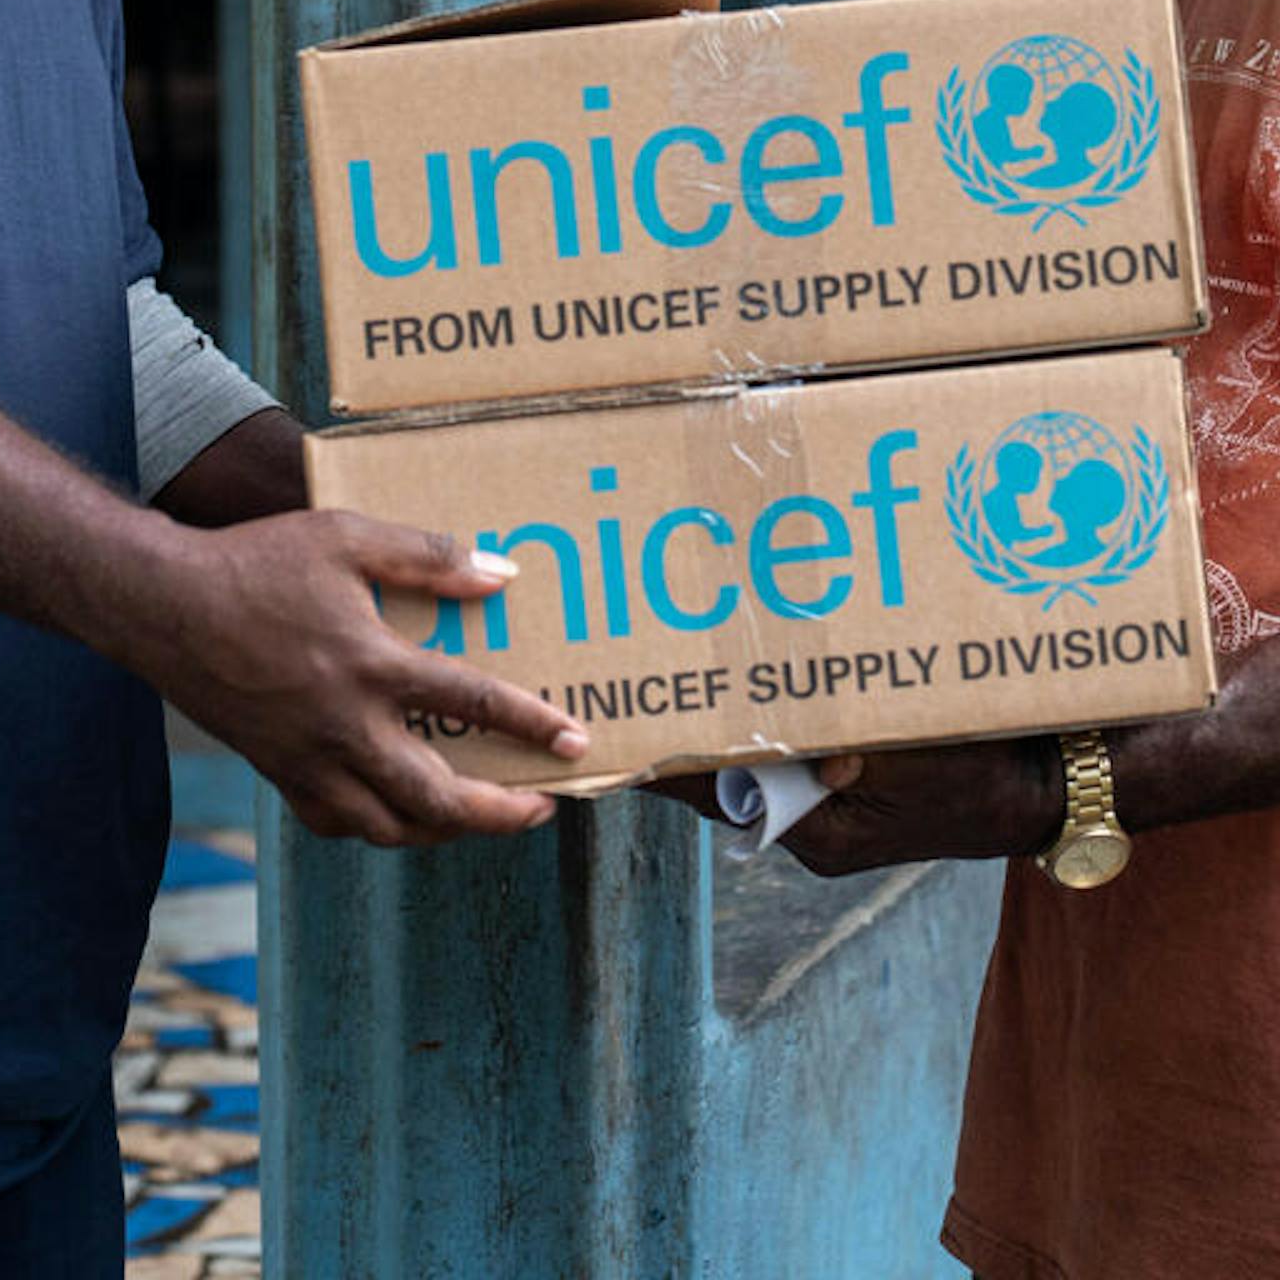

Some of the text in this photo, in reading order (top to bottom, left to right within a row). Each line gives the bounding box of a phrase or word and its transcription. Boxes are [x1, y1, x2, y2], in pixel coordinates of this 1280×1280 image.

[347, 51, 912, 279] unicef
[364, 307, 515, 359] FROM
[532, 286, 720, 342] UNICEF
[738, 266, 929, 322] SUPPLY
[949, 241, 1181, 300] DIVISION
[748, 646, 939, 704] SUPPLY
[959, 619, 1191, 680] DIVISION
